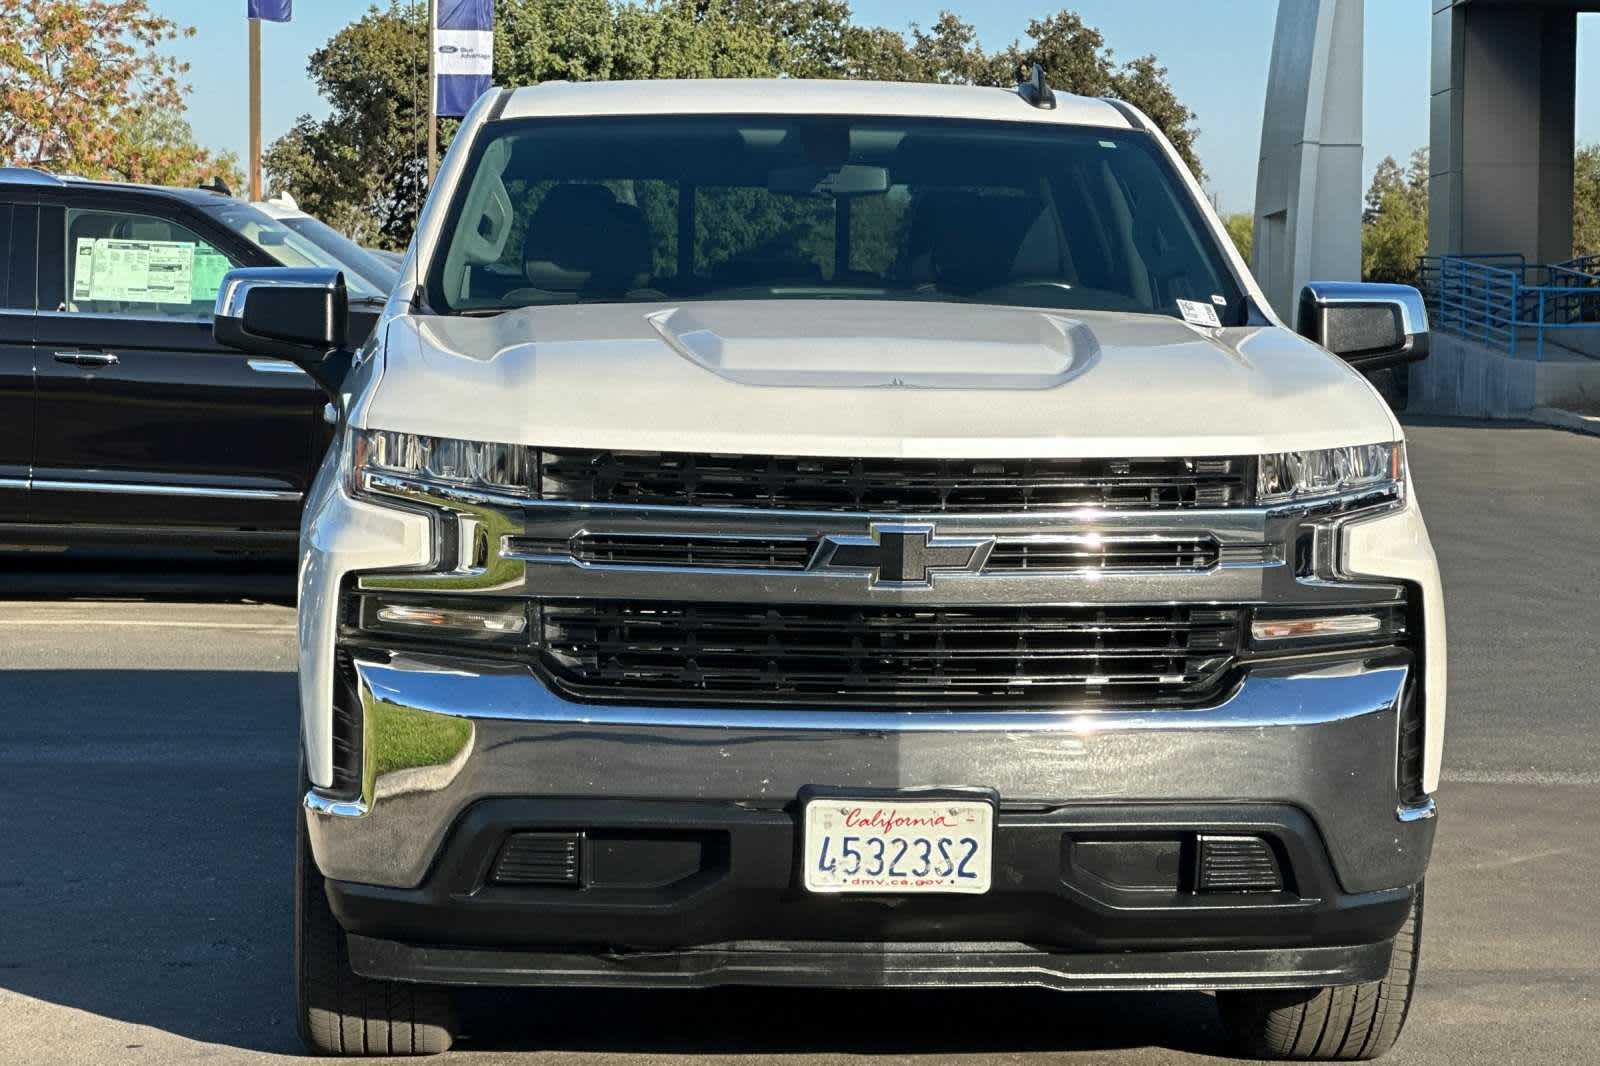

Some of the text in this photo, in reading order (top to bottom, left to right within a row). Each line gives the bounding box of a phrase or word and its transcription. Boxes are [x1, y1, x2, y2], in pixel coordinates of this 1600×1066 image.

[845, 808, 957, 833] California
[819, 836, 978, 878] 45323S2
[852, 879, 944, 887] dmv.ca.gov
